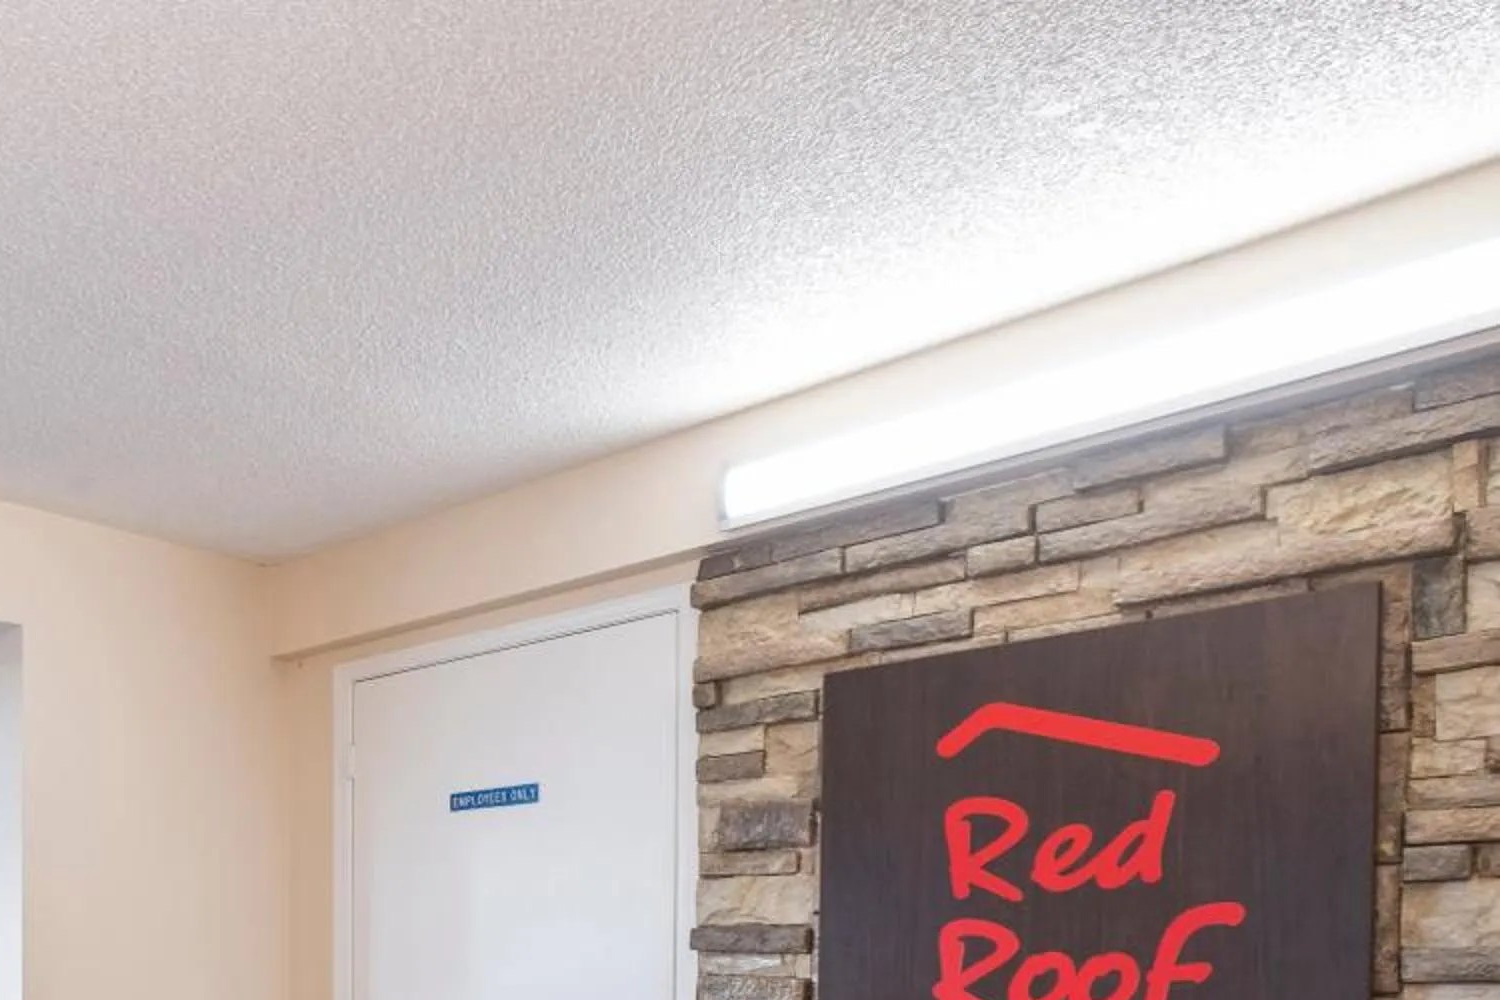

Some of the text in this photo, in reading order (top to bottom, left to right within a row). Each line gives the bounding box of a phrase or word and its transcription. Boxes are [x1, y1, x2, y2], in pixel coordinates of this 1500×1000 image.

[453, 787, 536, 808] EMPLOYEES ONLY
[944, 789, 1177, 902] Red
